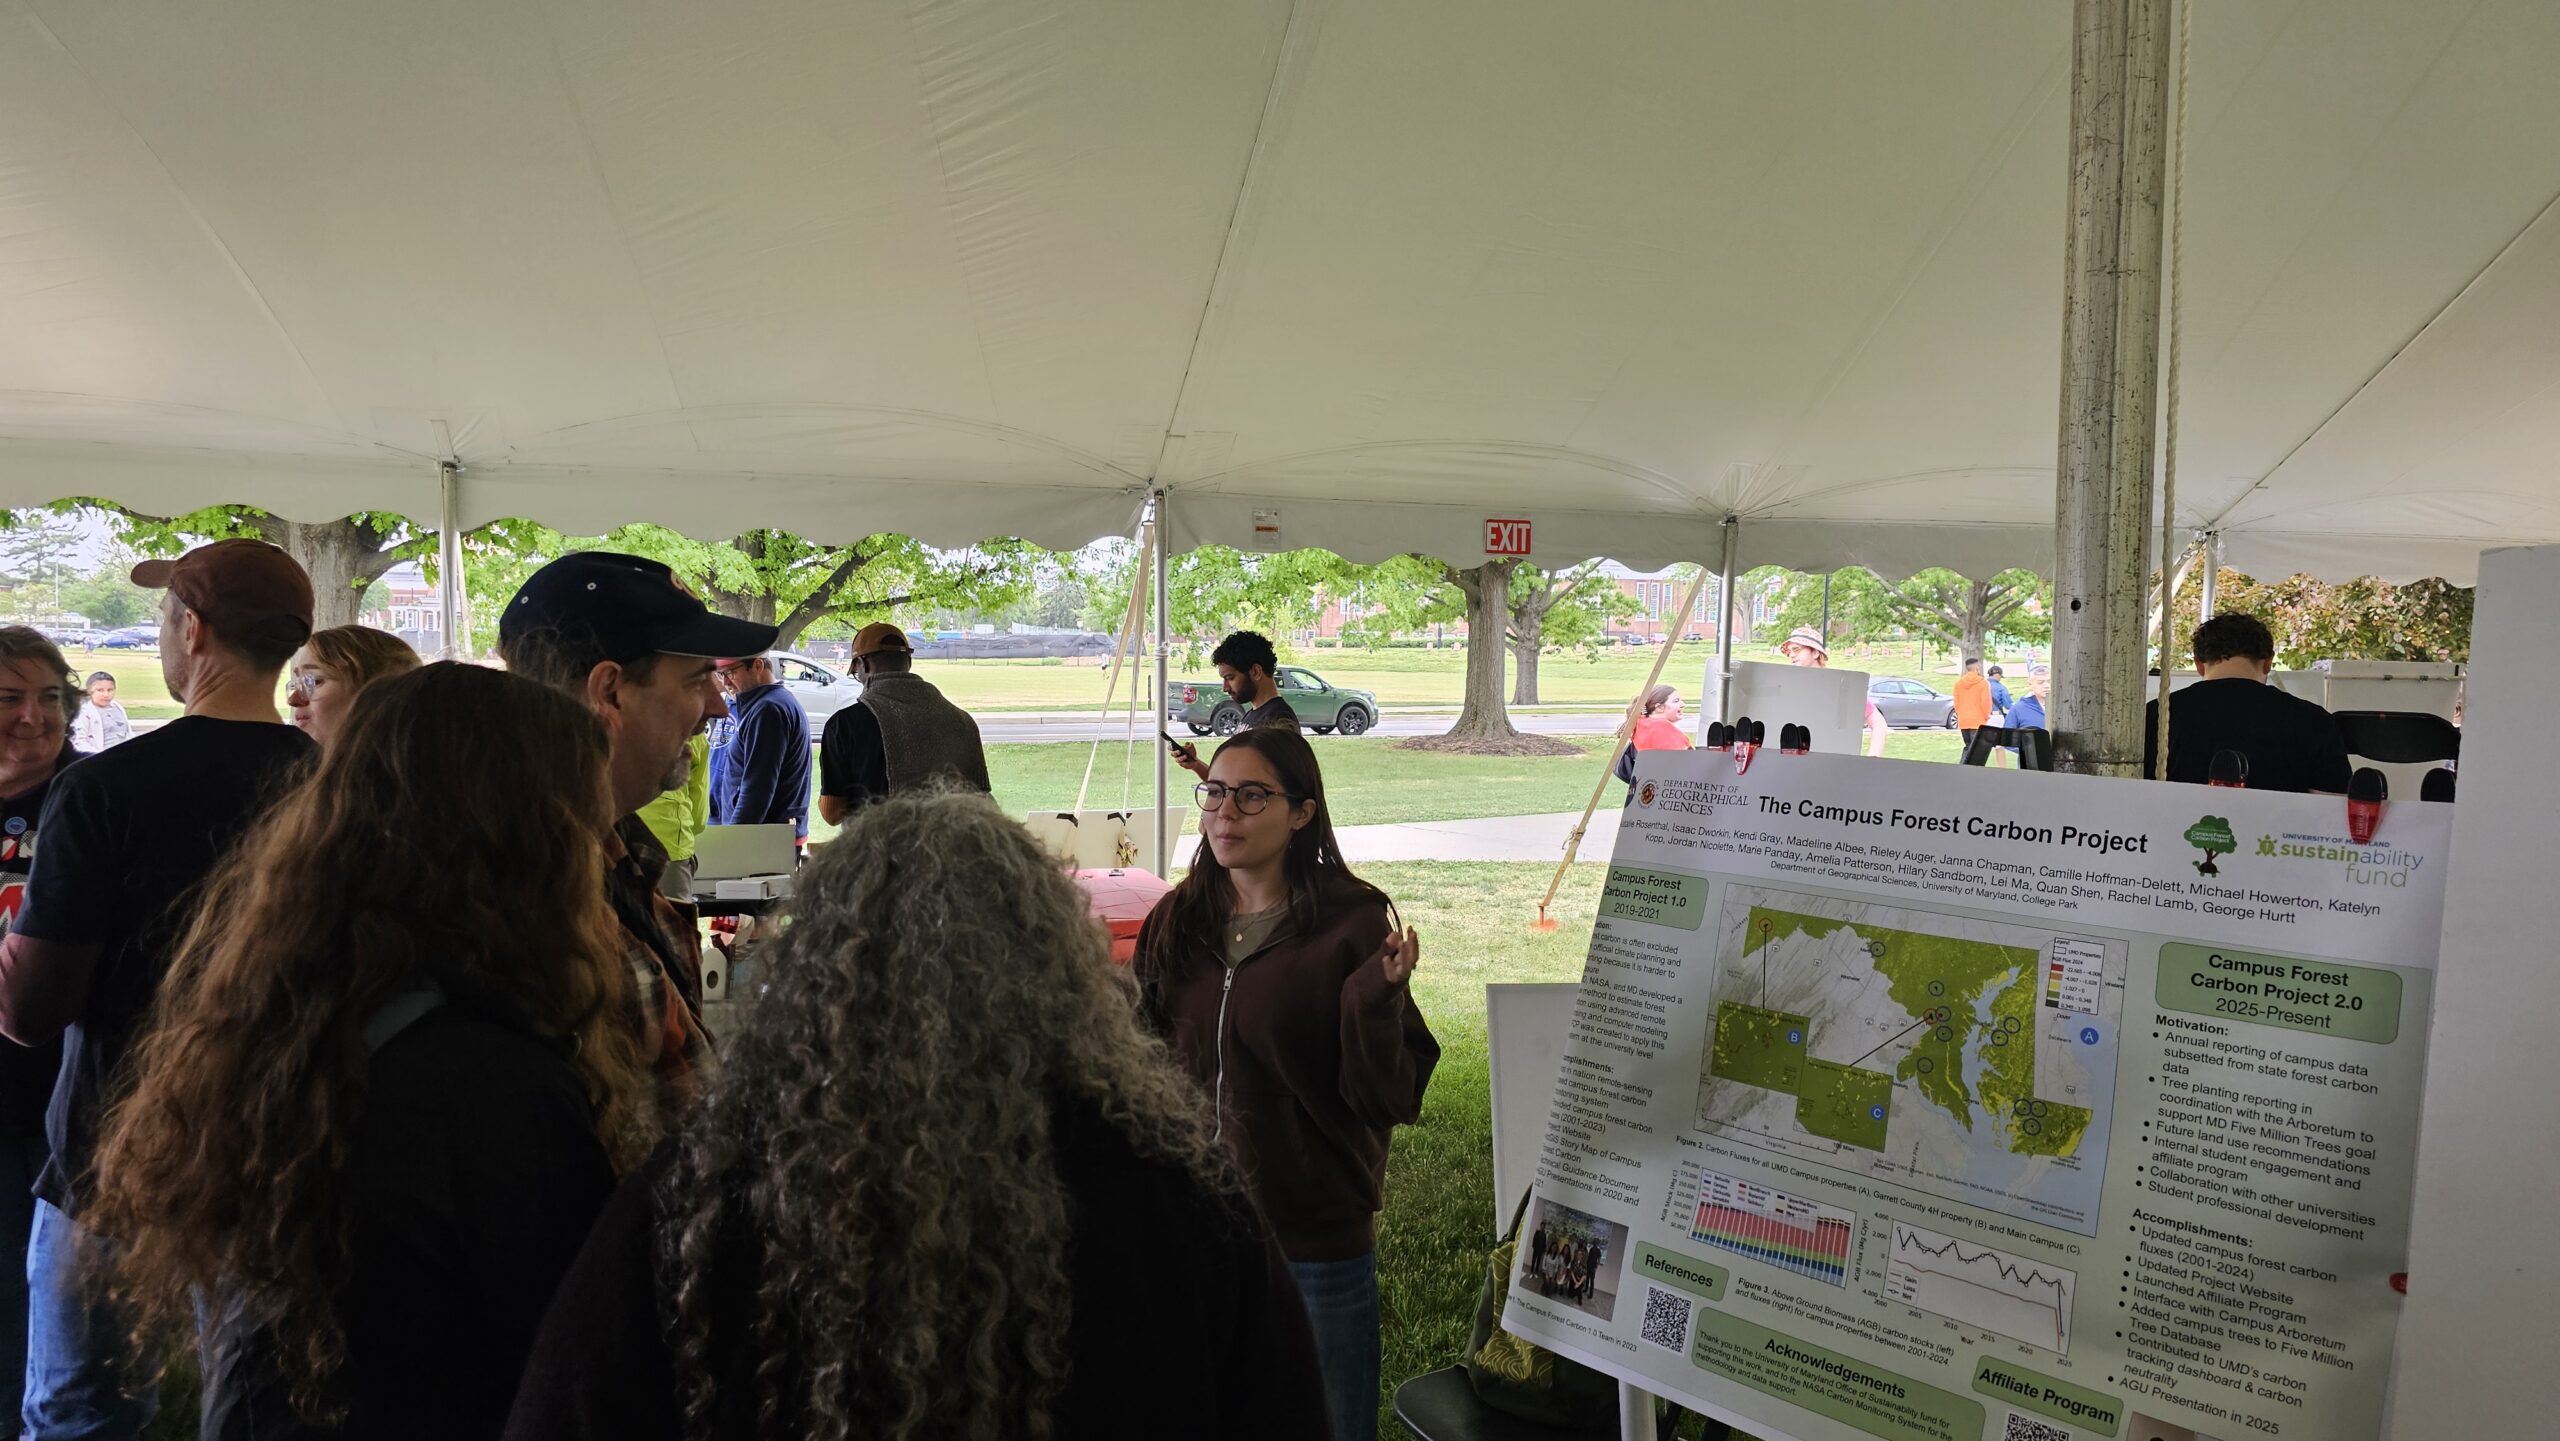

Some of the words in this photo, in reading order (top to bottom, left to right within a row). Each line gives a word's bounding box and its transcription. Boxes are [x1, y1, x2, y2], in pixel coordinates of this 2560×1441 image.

[1486, 522, 1530, 552] EXIT
[1662, 788, 1749, 806] GEOGRAPHICAL
[1663, 779, 1725, 792] DEPARTMENT
[1727, 785, 1738, 793] OF
[1659, 800, 1714, 816] SCIENCES
[1759, 795, 1791, 815] The
[1798, 799, 1883, 826] Campus
[1890, 808, 1960, 834] Forest
[1966, 816, 2052, 843] Carbon
[2060, 825, 2148, 854] Project
[2280, 843, 2424, 870] sustainability
[2282, 833, 2330, 842] UNIVERSITY
[1612, 870, 1646, 885] Campus
[1647, 874, 1681, 890] Forest
[1636, 820, 1669, 832] Rosenthal,
[1672, 822, 1696, 835] Isaac
[1697, 826, 1730, 842] Dworkin,
[1733, 829, 1758, 847] Kendi
[1759, 832, 1783, 846] Gray,
[1786, 835, 1832, 850] Madeline
[1834, 841, 1866, 855] Albee,
[1870, 845, 1901, 861] Rieley
[1902, 849, 1936, 864] Auger,
[1939, 854, 1973, 867] Janna
[1976, 858, 2035, 876] Chapman,
[2039, 865, 2082, 881] Camille
[2085, 870, 2184, 894] Hoffman-Delett,
[2189, 882, 2244, 900] Michael
[2249, 889, 2323, 911] Howerton,
[2328, 898, 2380, 917] Katelyn
[1644, 832, 1664, 843] Kopp,
[1667, 835, 1698, 847] Jordan
[1764, 846, 1802, 862] Panday,
[1805, 851, 1840, 866] Amelia
[1843, 856, 1894, 874] Patterson,
[1898, 863, 1928, 879] Hilary
[1930, 867, 1986, 886] Sandborn,
[1990, 875, 2008, 887] Lei
[2011, 877, 2032, 892] Ma,
[2036, 880, 2067, 895] Quan
[2070, 884, 2103, 901] Shen,
[2107, 889, 2151, 905] Rachel
[2155, 895, 2197, 912] Lamb,
[2202, 901, 2254, 920] George
[2259, 908, 2295, 924] Hurtt
[1770, 860, 1816, 874] Department
[1817, 867, 1826, 875] of
[1827, 868, 1880, 882] Geographical
[1881, 875, 1919, 888] Sciences,
[1922, 880, 1962, 895] University
[1964, 886, 1974, 895] of
[1975, 887, 2018, 902] Maryland,
[2021, 893, 2056, 907] College
[2058, 898, 2078, 909] Park
[2345, 863, 2408, 888] fund
[1604, 885, 1630, 898] Carbon
[1632, 889, 1668, 904] Project
[1671, 895, 1686, 907] 1.0
[1613, 902, 1659, 919] 2019-2021
[2208, 954, 2285, 978] Campus
[2290, 965, 2349, 986] Forest
[2190, 972, 2258, 995] Carbon
[2264, 982, 2330, 1006] Project
[2334, 993, 2362, 1010] 2.0
[2155, 1014, 2228, 1036] Motivation:
[2215, 997, 2331, 1033] 2025-Present
[2162, 1061, 2189, 1075] data
[2163, 1048, 2224, 1066] subsetted
[2227, 1056, 2254, 1072] from
[2257, 1064, 2287, 1078] state
[2291, 1068, 2328, 1086] forest
[2331, 1078, 2378, 1094] carbon
[2164, 1031, 2209, 1048] Annual
[2212, 1041, 2266, 1060] reporting
[2269, 1050, 2283, 1061] of
[2284, 1054, 2334, 1070] campus
[2338, 1062, 2368, 1076] data
[2161, 1075, 2188, 1090] Tree
[2191, 1082, 2239, 1103] planting
[2242, 1093, 2297, 1114] reporting
[2301, 1102, 2312, 1115] in
[2157, 1107, 2202, 1124] support
[2206, 1115, 2227, 1129] MD
[2230, 1120, 2256, 1136] Five
[2260, 1126, 2300, 1144] Million
[2304, 1135, 2341, 1153] Trees
[2344, 1146, 2376, 1160] goal
[2159, 1092, 2232, 1115] coordination
[2236, 1107, 2260, 1120] with
[2264, 1112, 2283, 1125] the
[2285, 1116, 2355, 1140] Arboretum
[2360, 1131, 2374, 1143] to
[2151, 1151, 2194, 1169] affiliate
[2196, 1162, 2248, 1181] program
[2154, 1135, 2198, 1154] Internal
[2201, 1148, 2247, 1166] student
[2249, 1158, 2331, 1184] engagement
[2334, 1177, 2361, 1190] and
[2156, 1120, 2194, 1138] Future
[2197, 1129, 2224, 1144] land
[2227, 1137, 2249, 1150] use
[2252, 1143, 2370, 1175] recommendations
[1675, 1134, 1697, 1147] Figure
[1705, 1143, 1728, 1156] Carbon
[1729, 1150, 1750, 1163] Fluxes
[1751, 1156, 1760, 1165] for
[1770, 1162, 1788, 1173] UMD
[1789, 1167, 1819, 1182] Campus
[1820, 1177, 1856, 1192] properties
[1873, 1190, 1898, 1204] Garrett
[1899, 1197, 1926, 1213] County
[1927, 1206, 1939, 1216] 4H
[1940, 1210, 1973, 1226] property
[1974, 1219, 1987, 1230] (B)
[1988, 1224, 2004, 1234] and
[2006, 1227, 2026, 1240] Main
[2028, 1233, 2064, 1250] Campus
[2148, 1180, 2194, 1201] Student
[2196, 1194, 2271, 1220] professional
[2275, 1211, 2364, 1240] development
[2150, 1165, 2228, 1193] Collaboration
[2231, 1186, 2257, 1200] with
[2260, 1193, 2294, 1208] other
[2297, 1202, 2375, 1226] universities
[2132, 1208, 2252, 1248] Accomplishments:
[1644, 1253, 1713, 1287] References
[2139, 1240, 2174, 1259] fluxes
[2177, 1250, 2254, 1282] (2001-2024)
[2142, 1225, 2192, 1248] Updated
[2194, 1242, 2244, 1262] campus
[2247, 1252, 2285, 1272] forest
[2289, 1265, 2336, 1282] carbon
[1764, 1338, 1905, 1398] Acknowledgements
[1978, 1368, 2038, 1398] Affiliate
[2042, 1388, 2114, 1424] Program
[2118, 1376, 2149, 1394] AGU
[2151, 1386, 2227, 1419] Presentation
[2230, 1409, 2242, 1423] in
[2245, 1414, 2279, 1434] 2025
